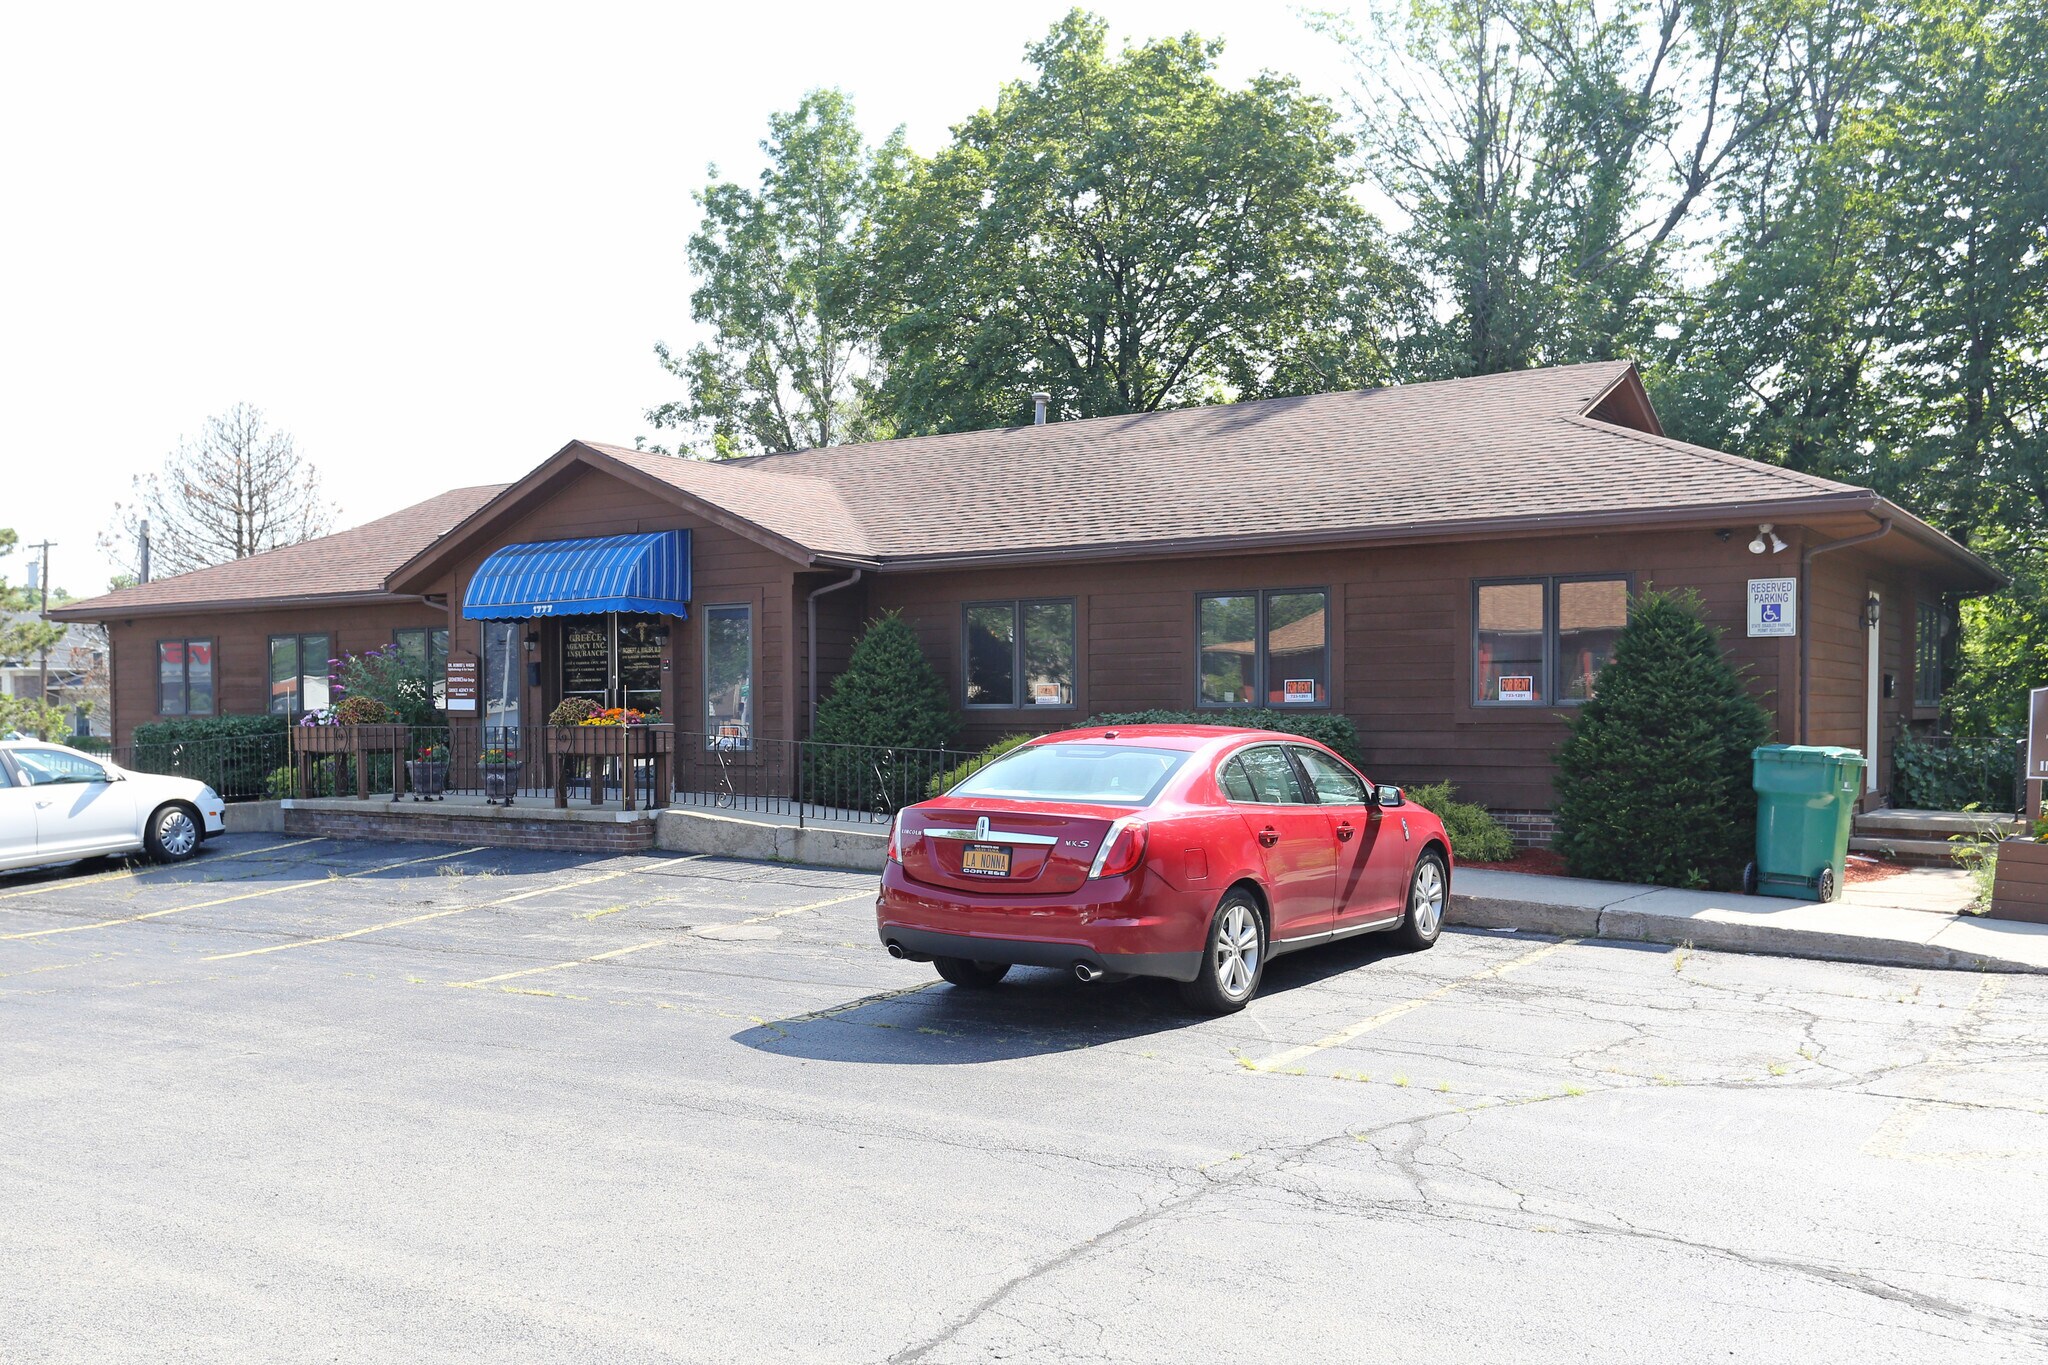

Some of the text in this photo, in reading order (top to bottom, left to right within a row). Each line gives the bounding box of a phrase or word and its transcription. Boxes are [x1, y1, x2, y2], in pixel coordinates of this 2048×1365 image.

[1751, 582, 1792, 593] RESERVED
[1754, 592, 1789, 603] PARKING
[532, 605, 552, 613] 1777
[569, 633, 602, 642] GREECE
[566, 642, 590, 650] AGENCY
[1513, 678, 1529, 691] RENT
[965, 852, 1006, 870] LA NONNA
[963, 868, 1006, 876] CORTESE
